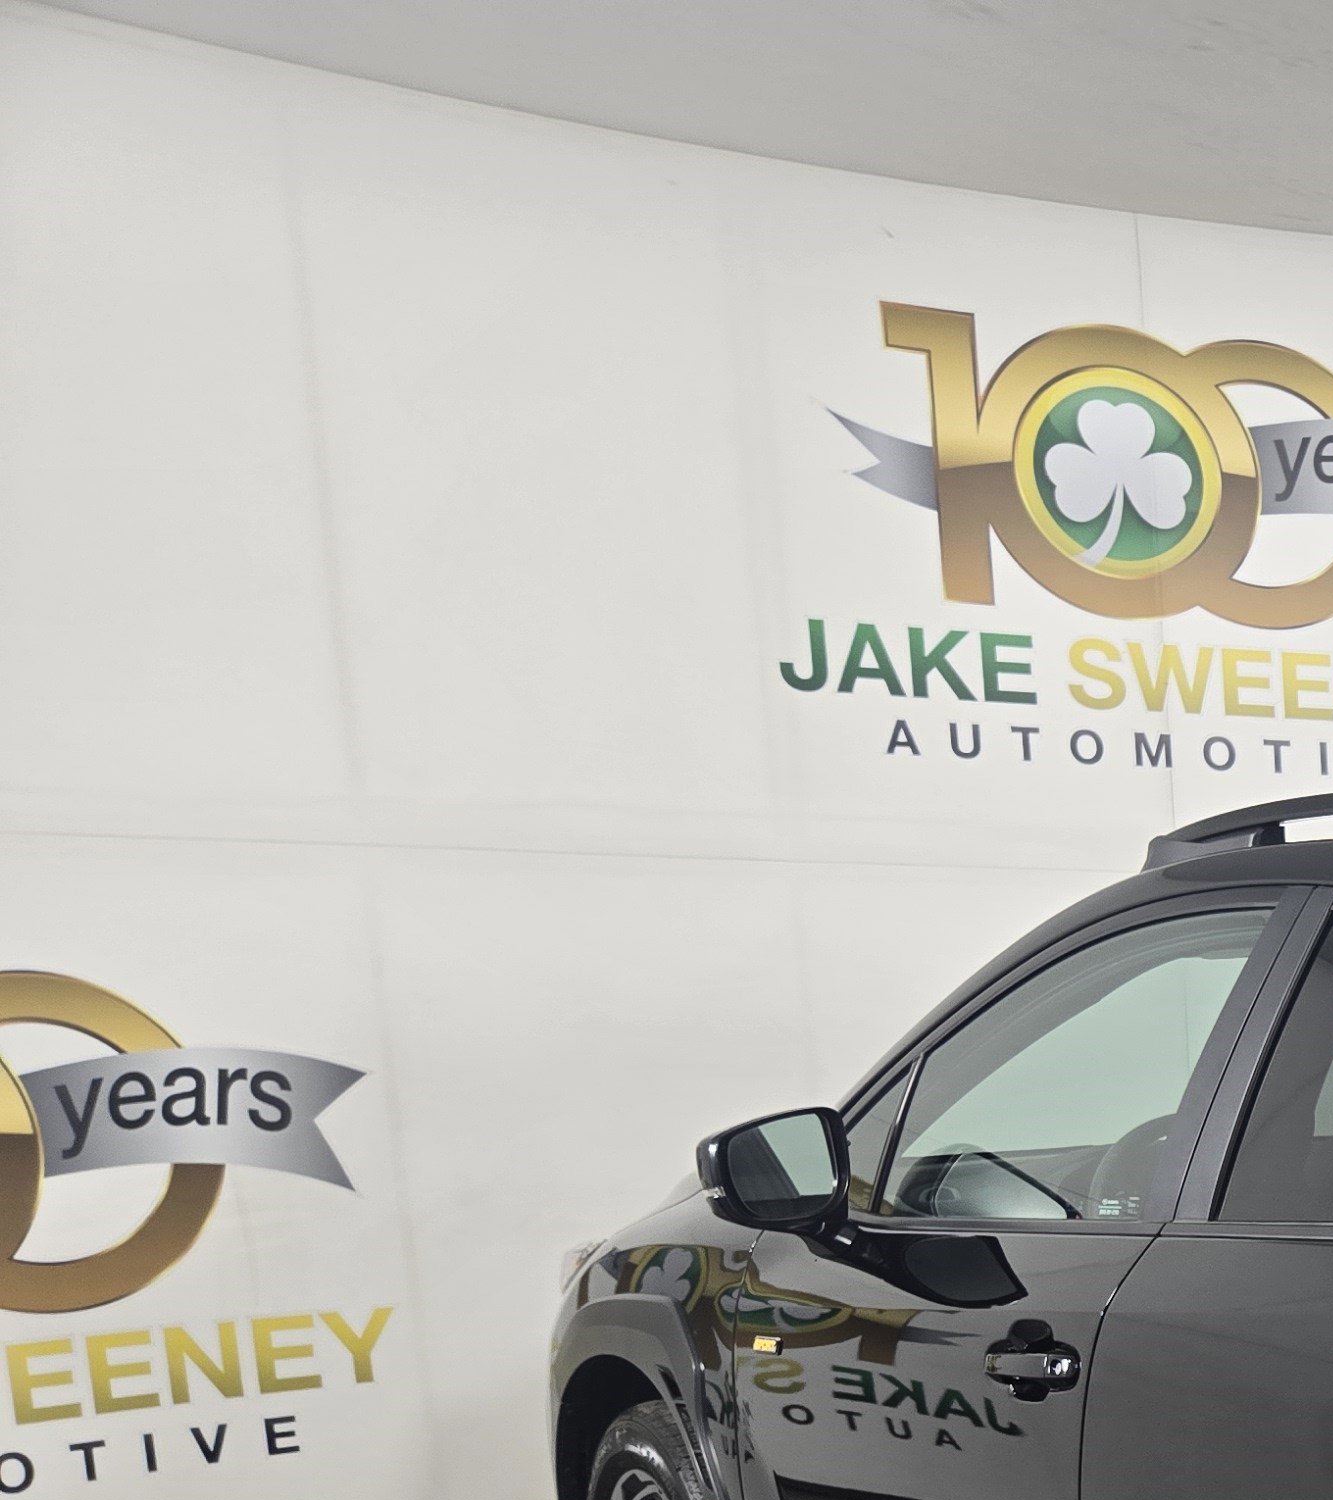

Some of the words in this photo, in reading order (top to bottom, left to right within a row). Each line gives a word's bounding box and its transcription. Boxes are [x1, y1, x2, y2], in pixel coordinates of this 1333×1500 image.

[779, 618, 1038, 706] JAKE
[53, 1065, 293, 1160] years
[6, 1307, 393, 1424] EENEY
[0, 1415, 300, 1493] OTIVE
